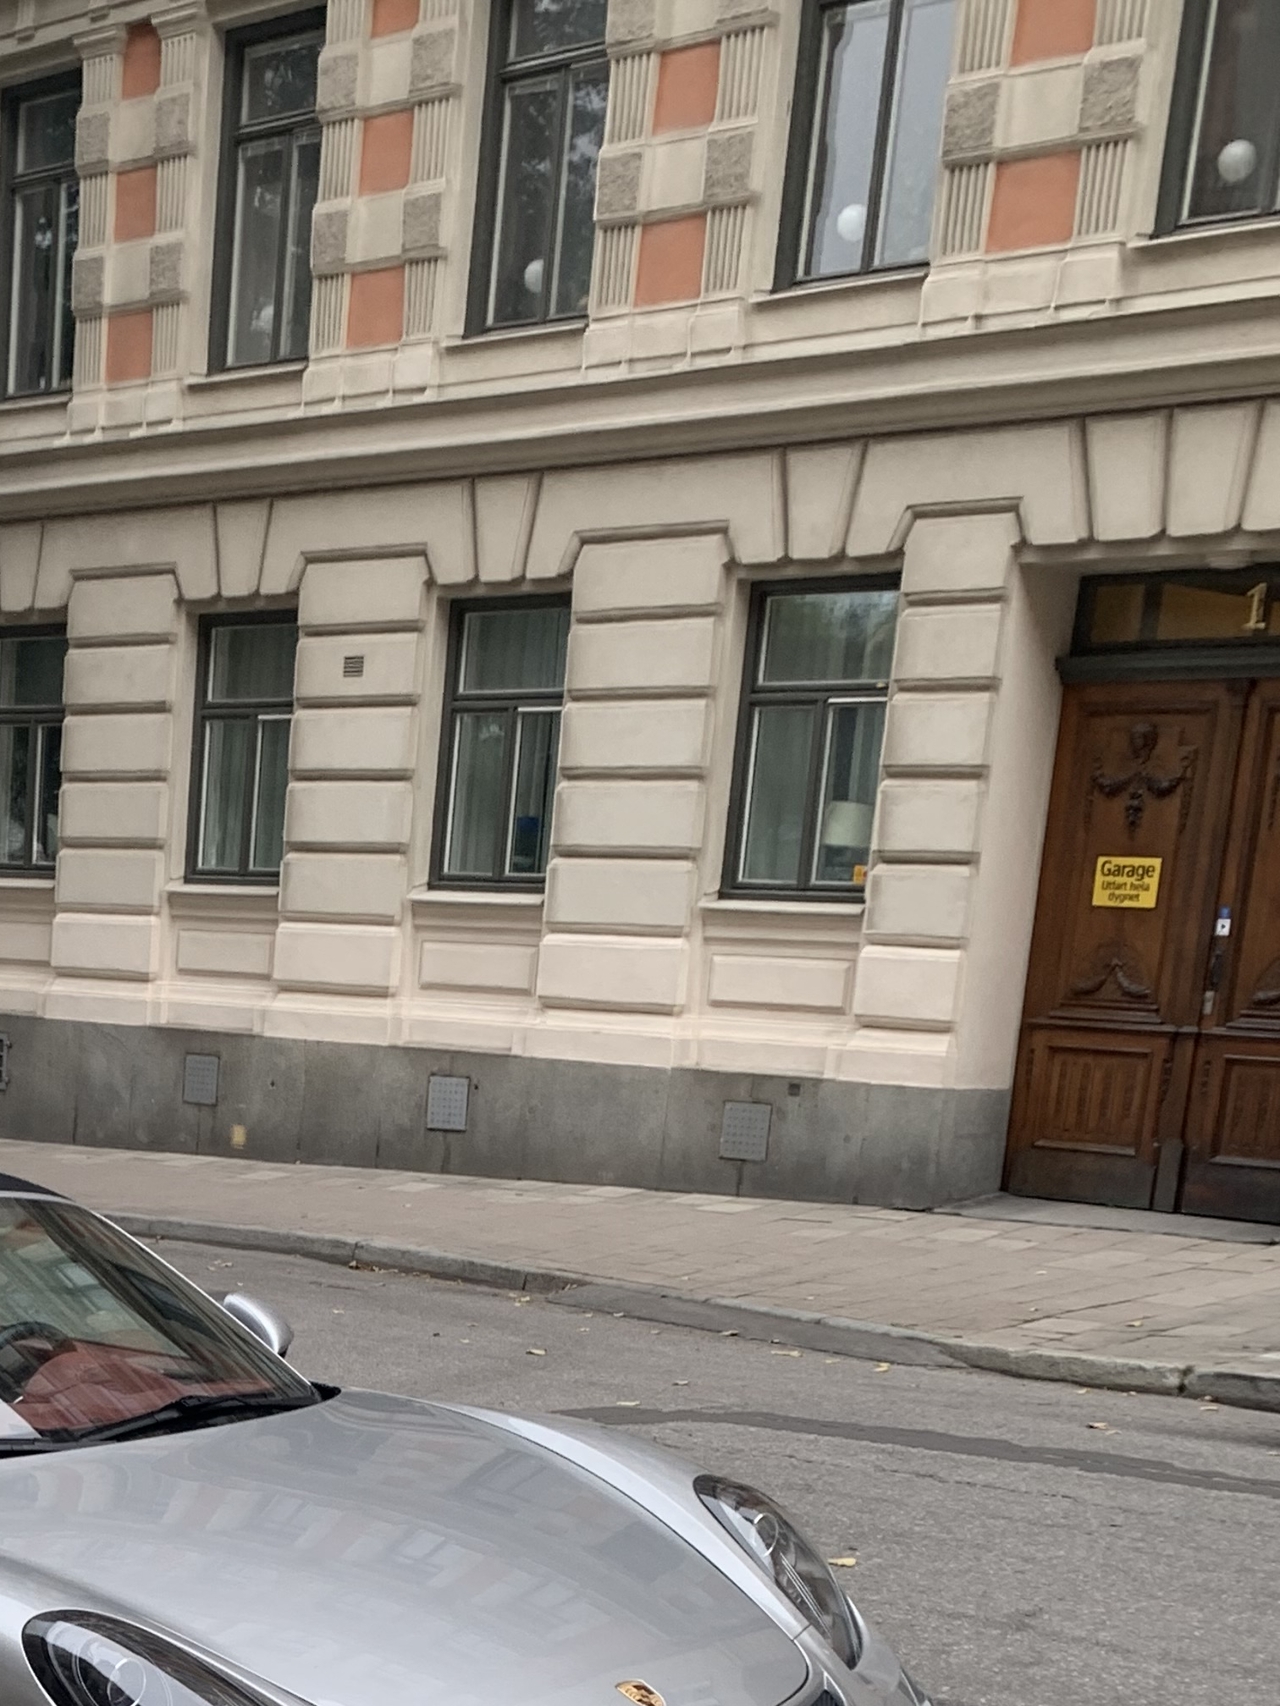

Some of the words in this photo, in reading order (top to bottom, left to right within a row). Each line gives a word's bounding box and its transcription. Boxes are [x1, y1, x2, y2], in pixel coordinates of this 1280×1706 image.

[1241, 582, 1267, 630] 1
[1101, 860, 1155, 881] Garage
[1108, 892, 1140, 904] dygnet
